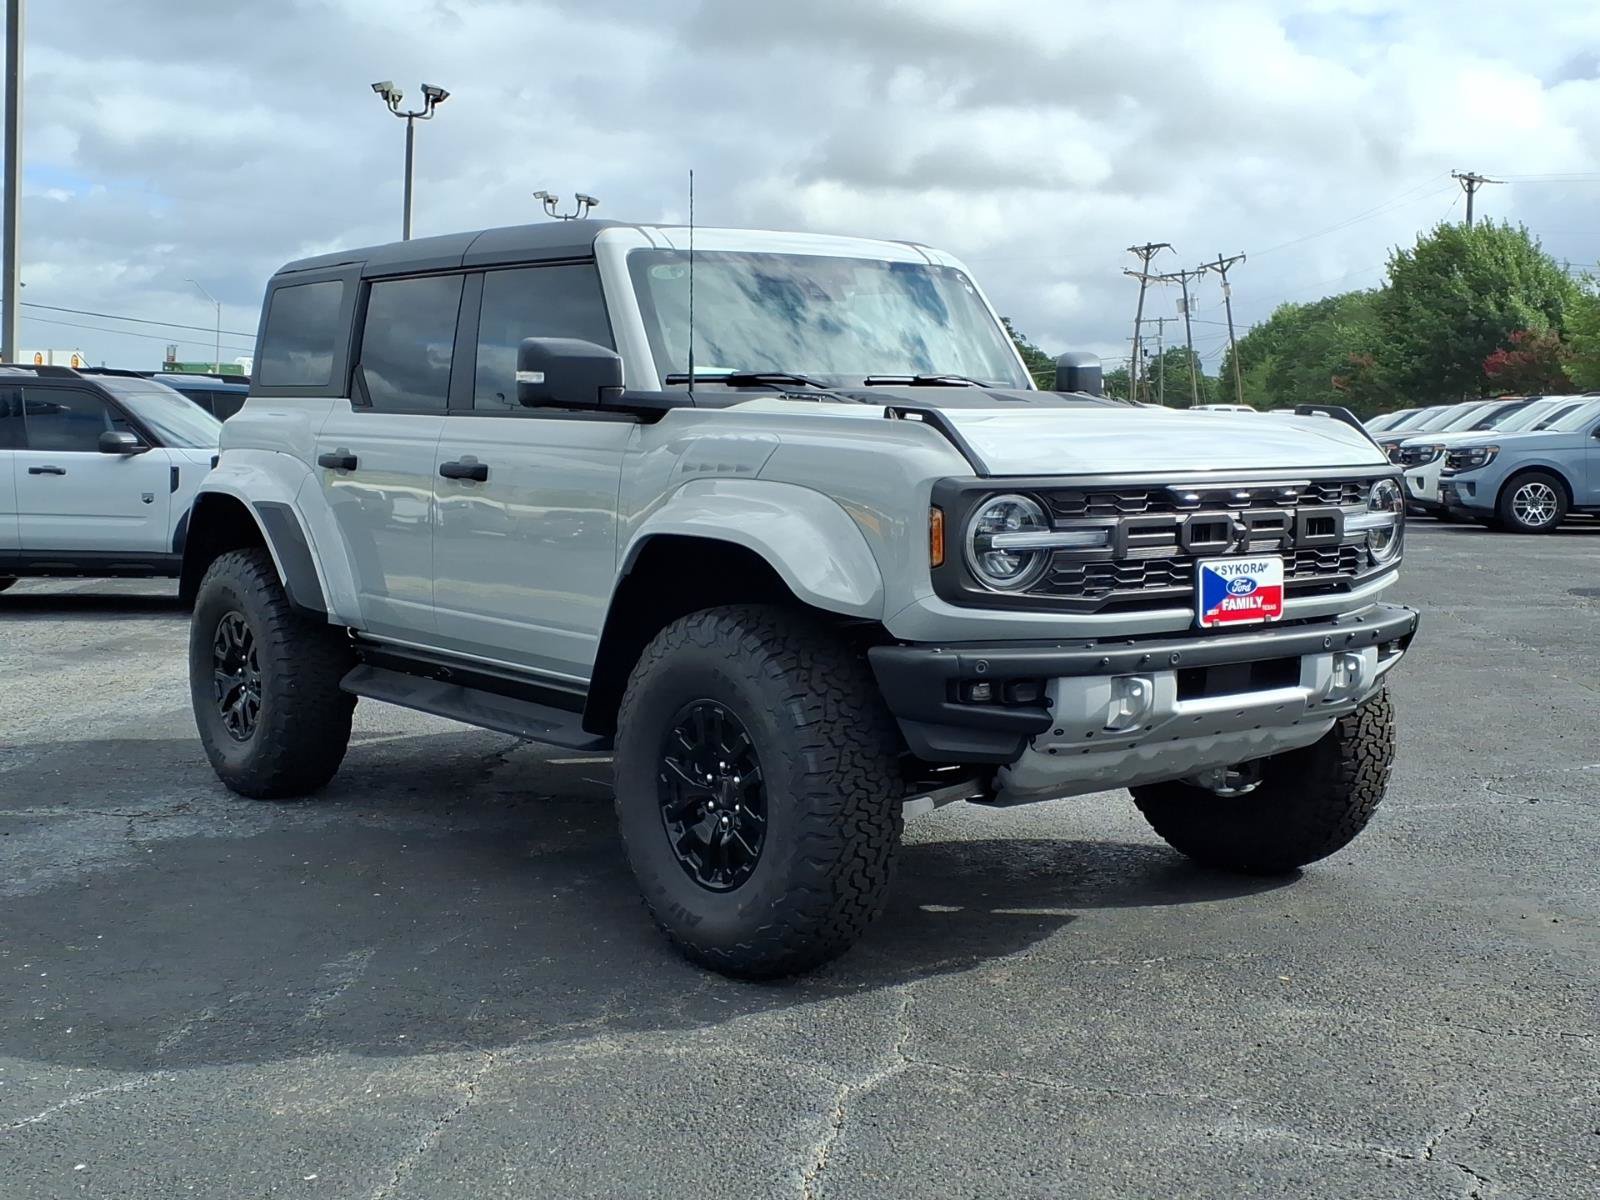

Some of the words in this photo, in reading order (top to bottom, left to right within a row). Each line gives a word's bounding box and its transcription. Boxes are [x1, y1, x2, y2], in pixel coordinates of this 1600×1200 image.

[1118, 507, 1344, 560] FORD
[1221, 562, 1264, 576] SYKORA
[1231, 579, 1252, 593] Ford
[1221, 596, 1264, 611] FAMILY
